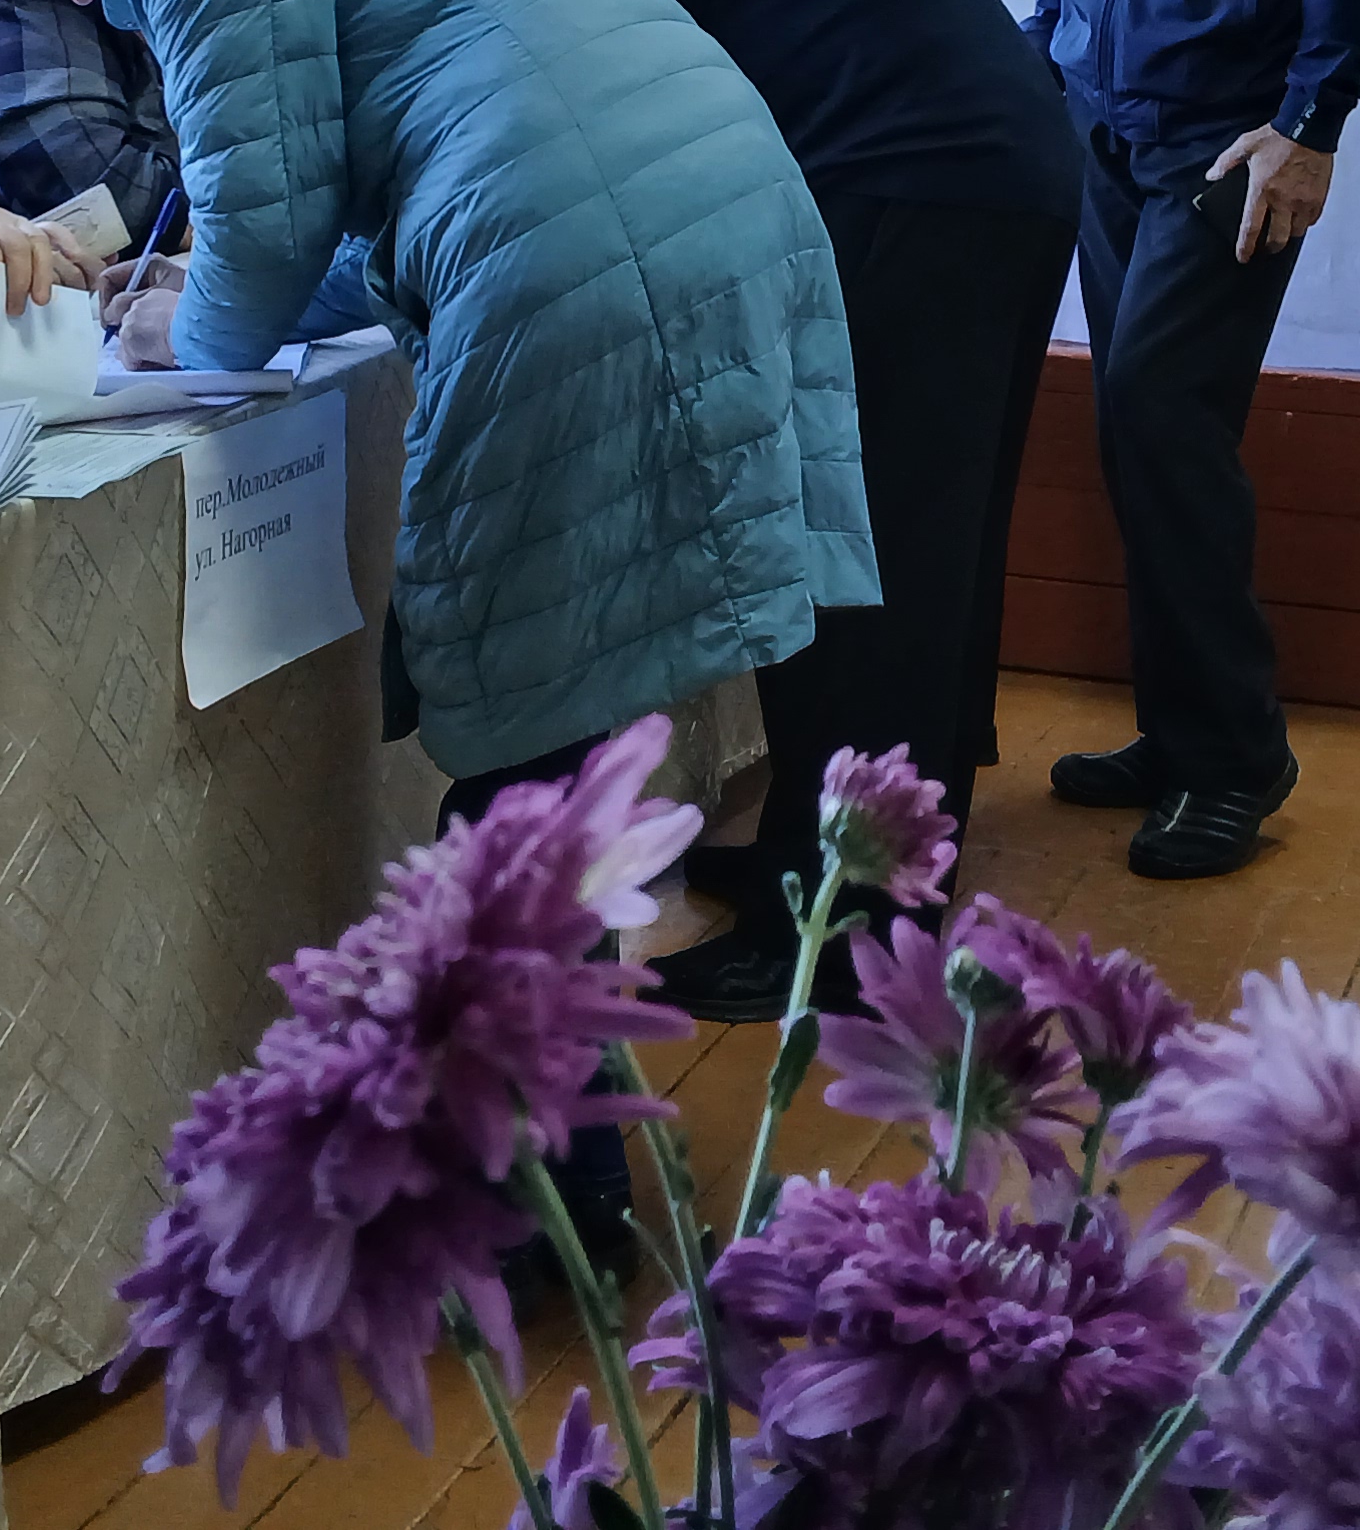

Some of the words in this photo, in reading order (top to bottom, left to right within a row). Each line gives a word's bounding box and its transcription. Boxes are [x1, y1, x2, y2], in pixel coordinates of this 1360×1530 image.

[195, 443, 326, 521] пер.Молодежный
[194, 547, 217, 581] ул.
[221, 513, 292, 560] Нагорная
